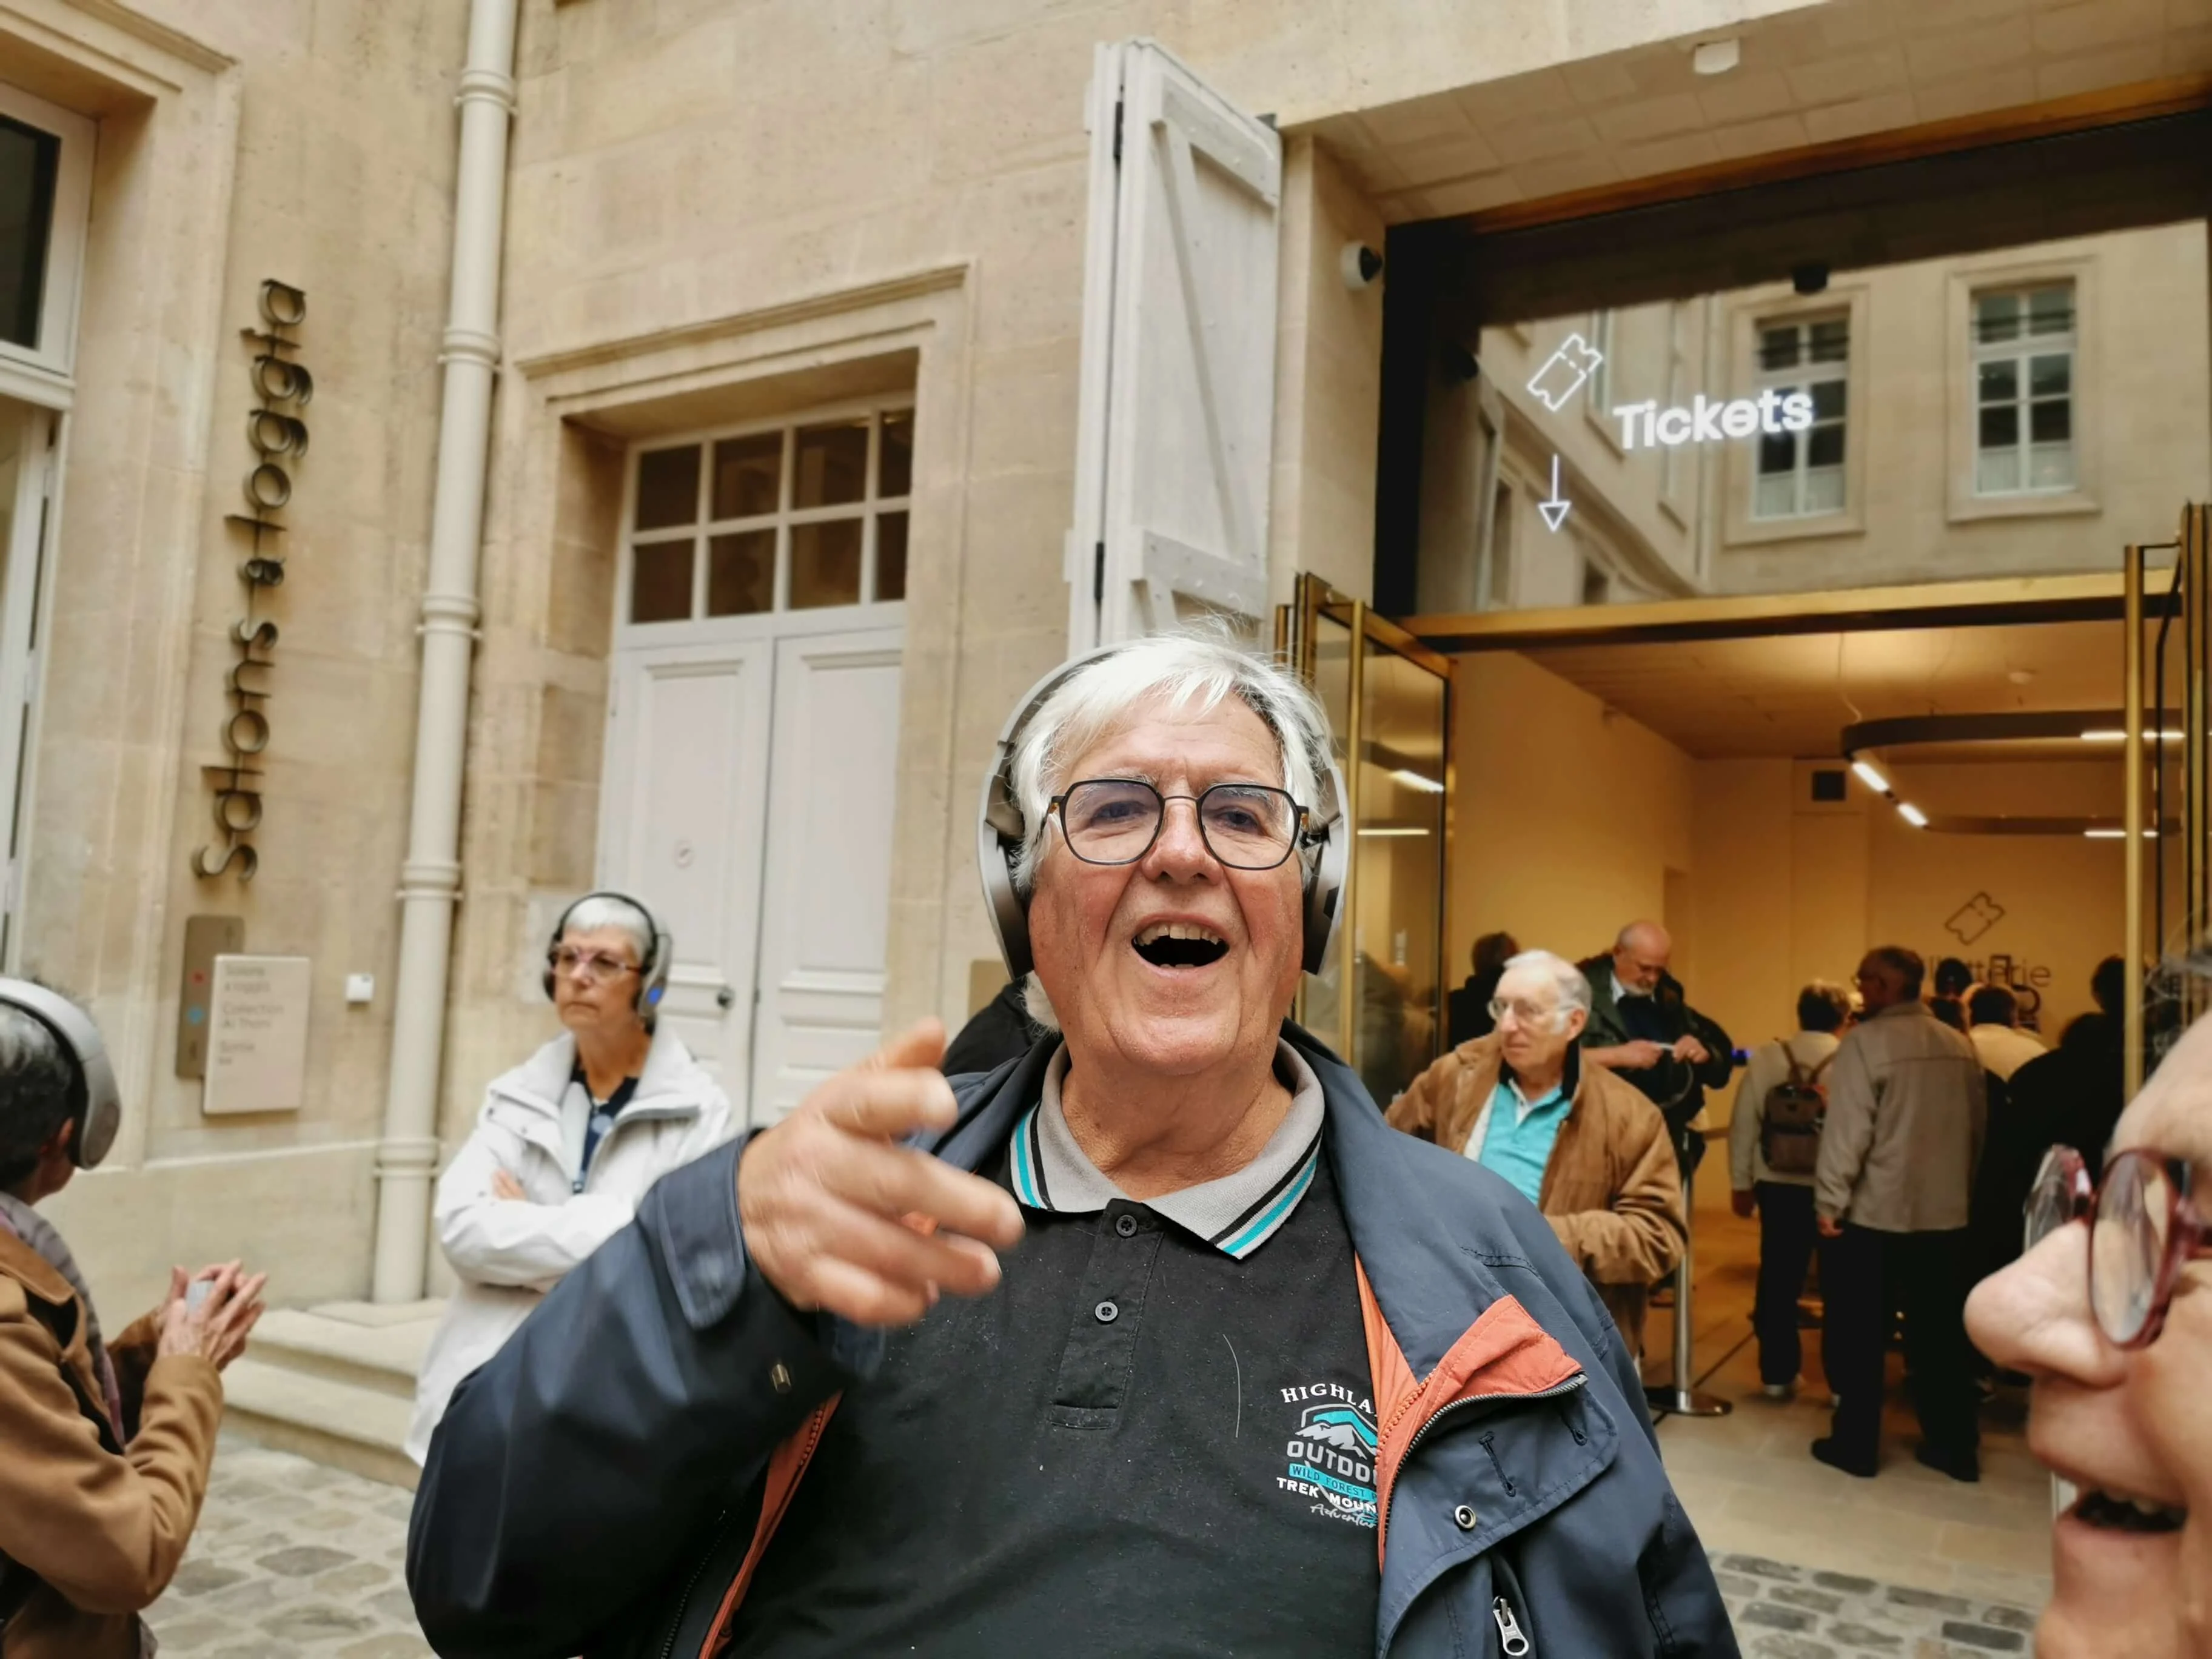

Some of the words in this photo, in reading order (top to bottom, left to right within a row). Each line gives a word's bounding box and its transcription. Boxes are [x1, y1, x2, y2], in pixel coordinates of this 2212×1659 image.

[223, 278, 313, 533] loggia
[1612, 389, 1813, 450] Tickets
[192, 617, 279, 882] Salons
[1281, 1383, 1377, 1416] HIGHLA
[1287, 1441, 1377, 1485] OUTDO
[1293, 1465, 1319, 1481] WILD
[1326, 1479, 1366, 1496] FOREST
[1276, 1477, 1319, 1498] TREK
